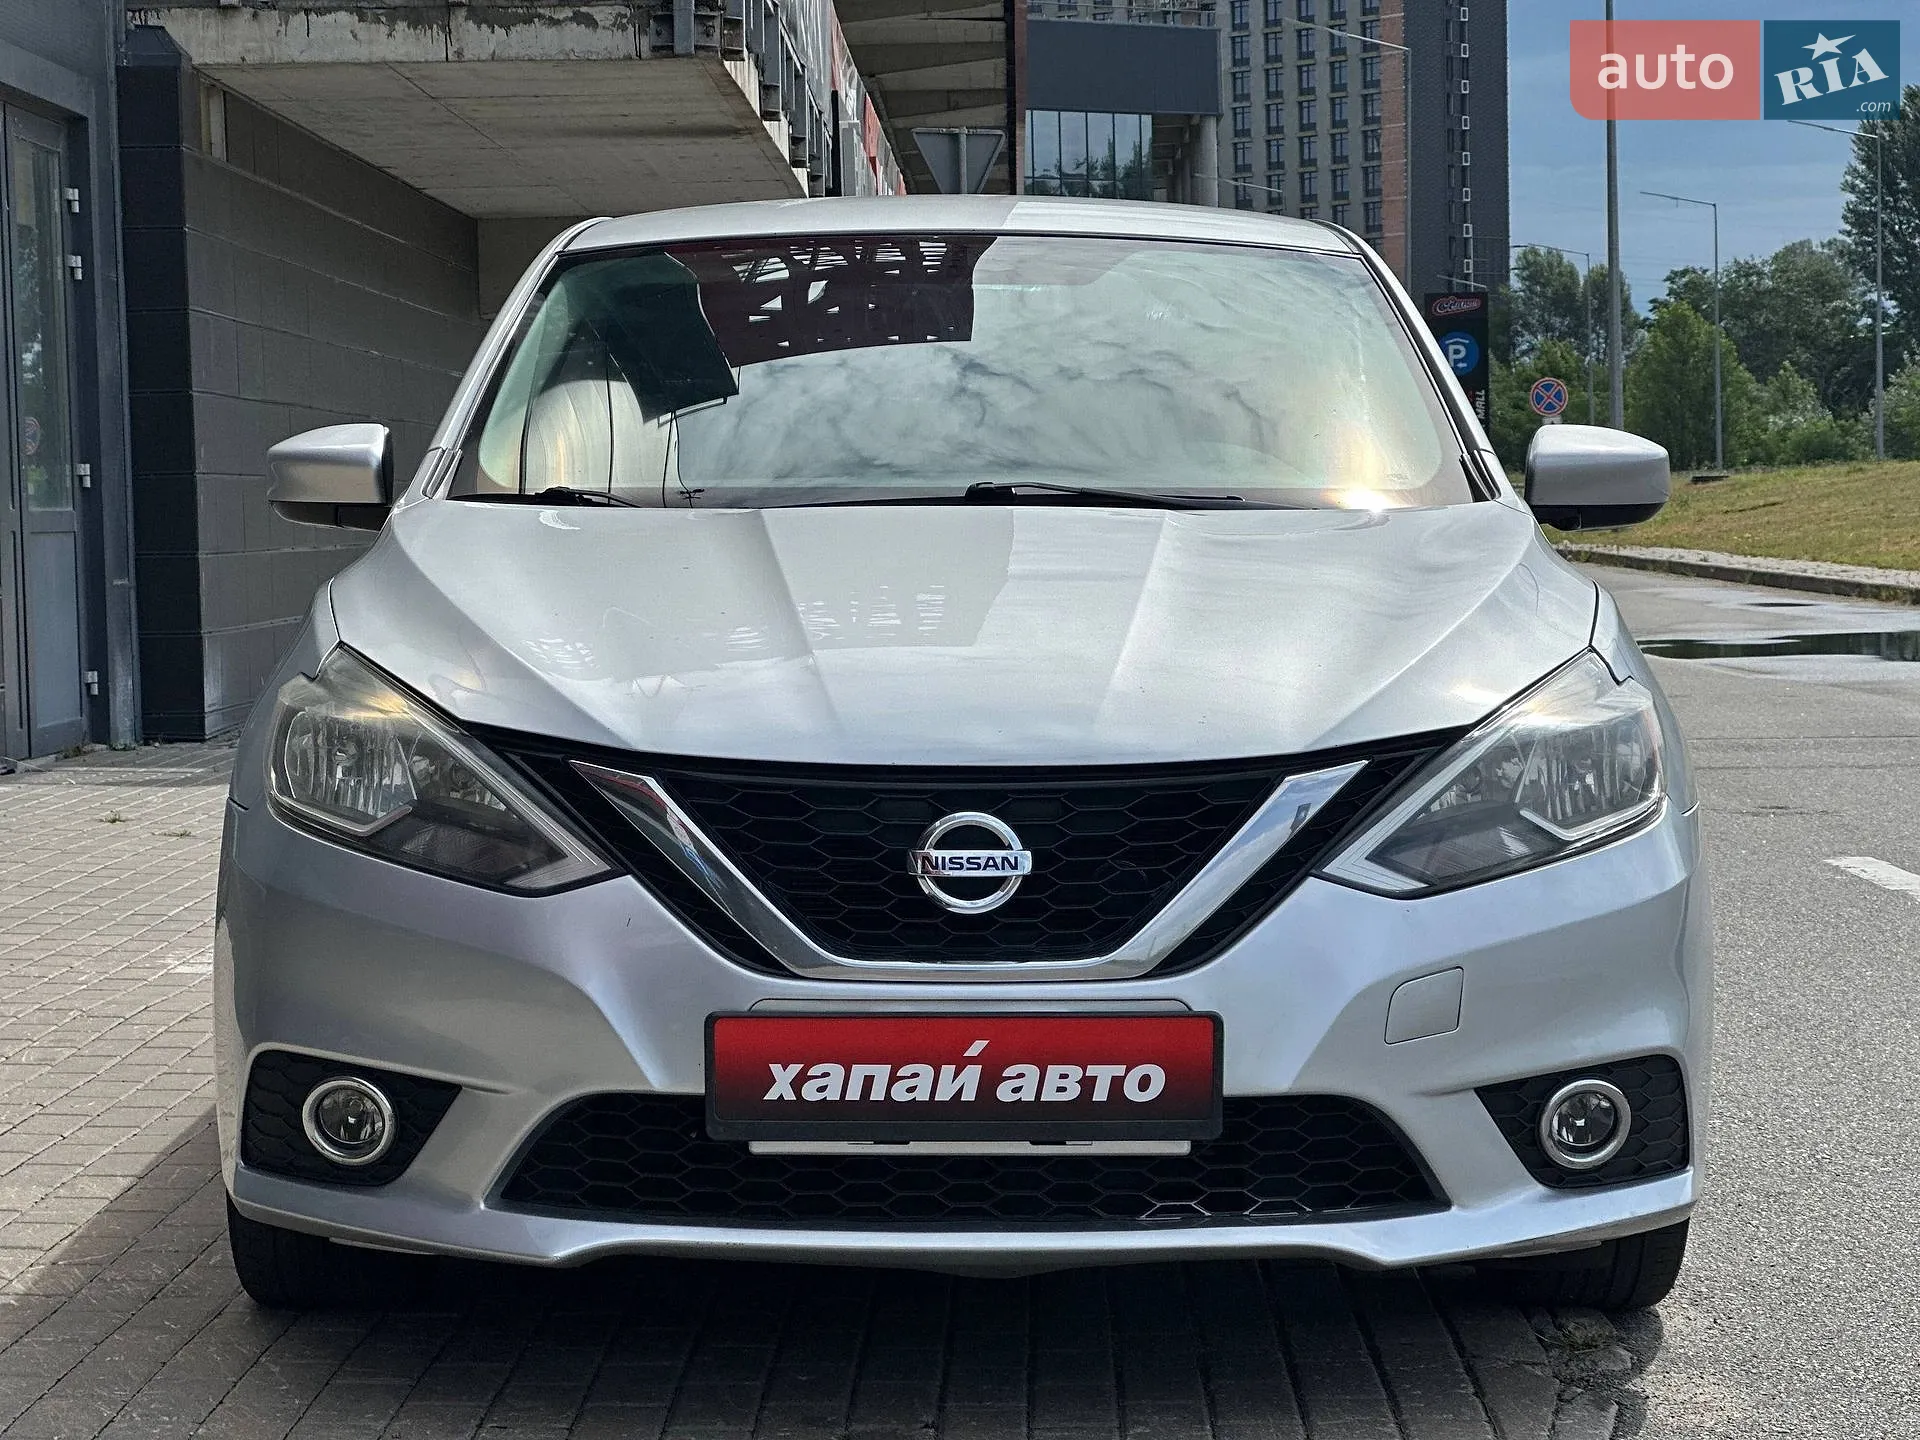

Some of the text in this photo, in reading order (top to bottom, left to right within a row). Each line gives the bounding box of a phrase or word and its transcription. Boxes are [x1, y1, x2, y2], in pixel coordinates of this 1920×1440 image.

[1448, 344, 1467, 368] P
[1476, 389, 1486, 419] MALL
[921, 856, 1019, 871] NISSAN
[995, 1063, 1167, 1103] авто
